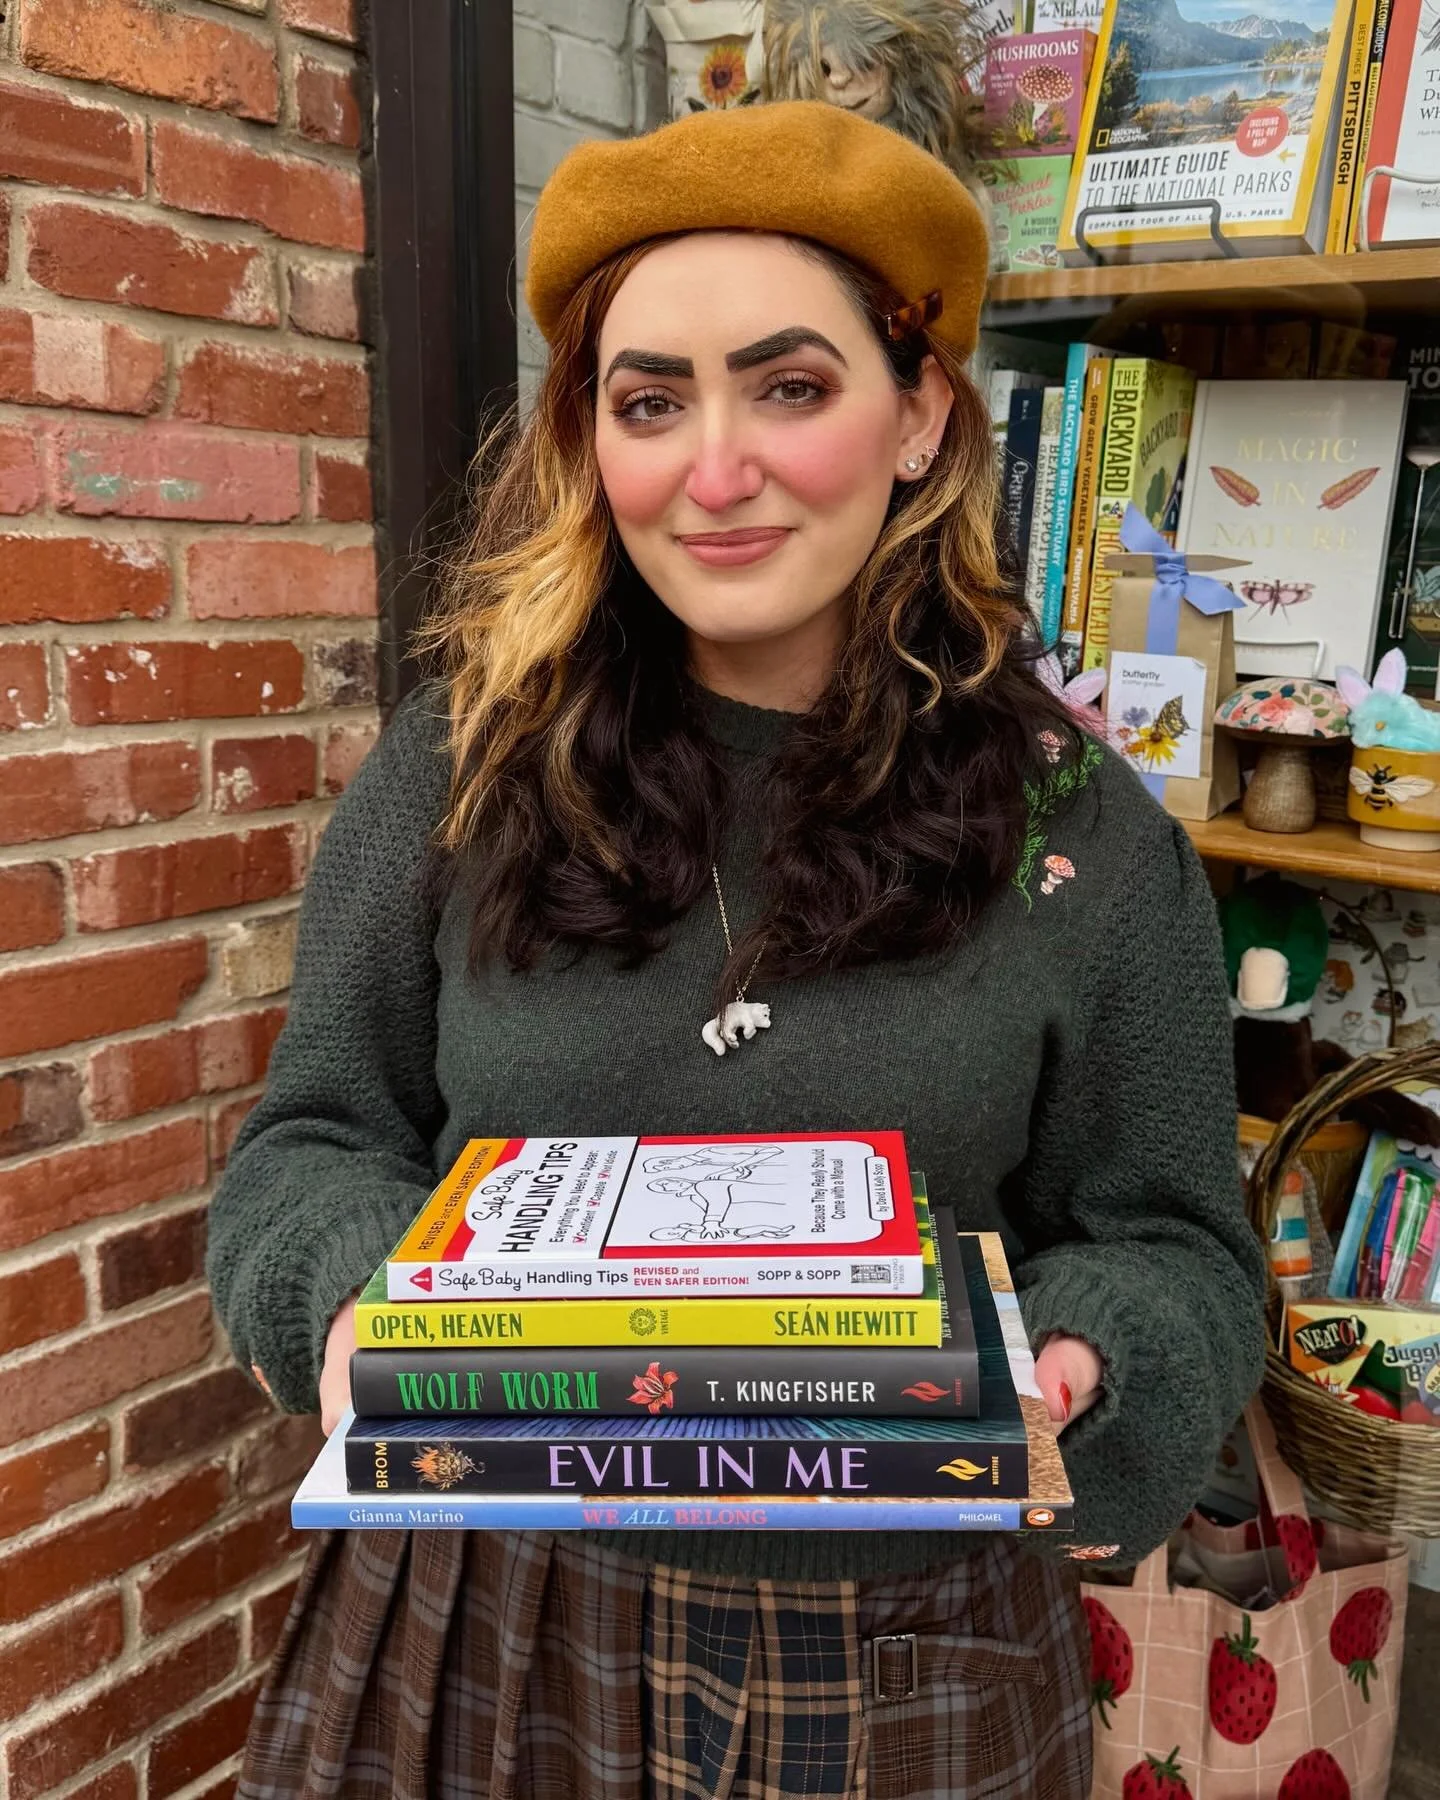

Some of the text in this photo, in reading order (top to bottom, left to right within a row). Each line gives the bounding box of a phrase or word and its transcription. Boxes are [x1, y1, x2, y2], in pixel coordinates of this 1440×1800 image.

[1373, 0, 1390, 54] ALCONGUIDES
[990, 39, 1080, 63] MUSHROOMS
[1336, 23, 1367, 185] BEST HIKES PITTSBURGH
[1109, 131, 1150, 145] GEOGRAPHIC
[1110, 127, 1142, 137] NATIONAL
[1089, 150, 1230, 182] ULTIMATE GUIDE
[1086, 170, 1293, 207] TO THE NATIONAL PARKS
[1088, 219, 1136, 230] COMPLETE
[1140, 217, 1164, 226] TOUR
[1185, 214, 1203, 222] ALL
[1225, 210, 1247, 219] U.S.
[1250, 208, 1284, 217] PARKS
[1067, 378, 1079, 401] THE
[1088, 394, 1098, 426] GROW
[1061, 404, 1077, 466] BACKYARD
[1104, 370, 1140, 492] THE BACKYARD
[1085, 430, 1096, 464] GREAT
[1235, 437, 1359, 464] MAGIC
[1041, 444, 1060, 518] BEATRIX
[1058, 469, 1071, 498] BIRD
[1273, 481, 1308, 506] IN
[1078, 466, 1092, 532] VEGETABLES
[1051, 500, 1067, 567] SANCTUARY
[1076, 534, 1086, 546] IN
[1210, 522, 1358, 550] NATURE
[1069, 547, 1084, 625] PENNSYLVANIA
[1122, 670, 1160, 680] butterfly
[456, 1171, 476, 1192] SAFER
[578, 1171, 591, 1179] to
[830, 1158, 844, 1180] Manual
[471, 1170, 534, 1221] Safe Baby
[497, 1142, 578, 1252] HANDLING TIPS
[570, 1178, 588, 1194] Need
[810, 1148, 828, 1232] Because They Really Should
[830, 1186, 845, 1200] with
[876, 1192, 888, 1206] David
[445, 1192, 464, 1208] EVEN
[564, 1195, 582, 1207] You
[830, 1200, 846, 1220] Come
[441, 1208, 454, 1220] and
[549, 1208, 580, 1242] Everything
[576, 1210, 597, 1240] Confident
[418, 1220, 446, 1250] REVISED
[438, 1266, 700, 1292] Safe Baby Handling Tips REVISED and
[633, 1276, 750, 1286] EVEN SAFER EDITION!
[757, 1269, 841, 1281] SOPP & SOPP
[660, 1309, 670, 1335] VINTAGE
[774, 1304, 918, 1336] SEÁN HEWITT
[940, 1300, 950, 1319] YORK
[371, 1313, 524, 1342] OPEN, HEAVEN
[942, 1323, 953, 1339] NEW
[396, 1371, 600, 1411] WOLF WORM
[706, 1380, 876, 1402] T. KINGFISHER
[376, 1442, 388, 1488] BROM
[548, 1445, 869, 1489] EVIL IN ME
[991, 1455, 1000, 1486] NIGHTFIRE
[349, 1508, 464, 1524] Gianna Marino
[583, 1508, 768, 1526] WE ALL BELONG
[959, 1513, 1003, 1523] PHILOMEL
